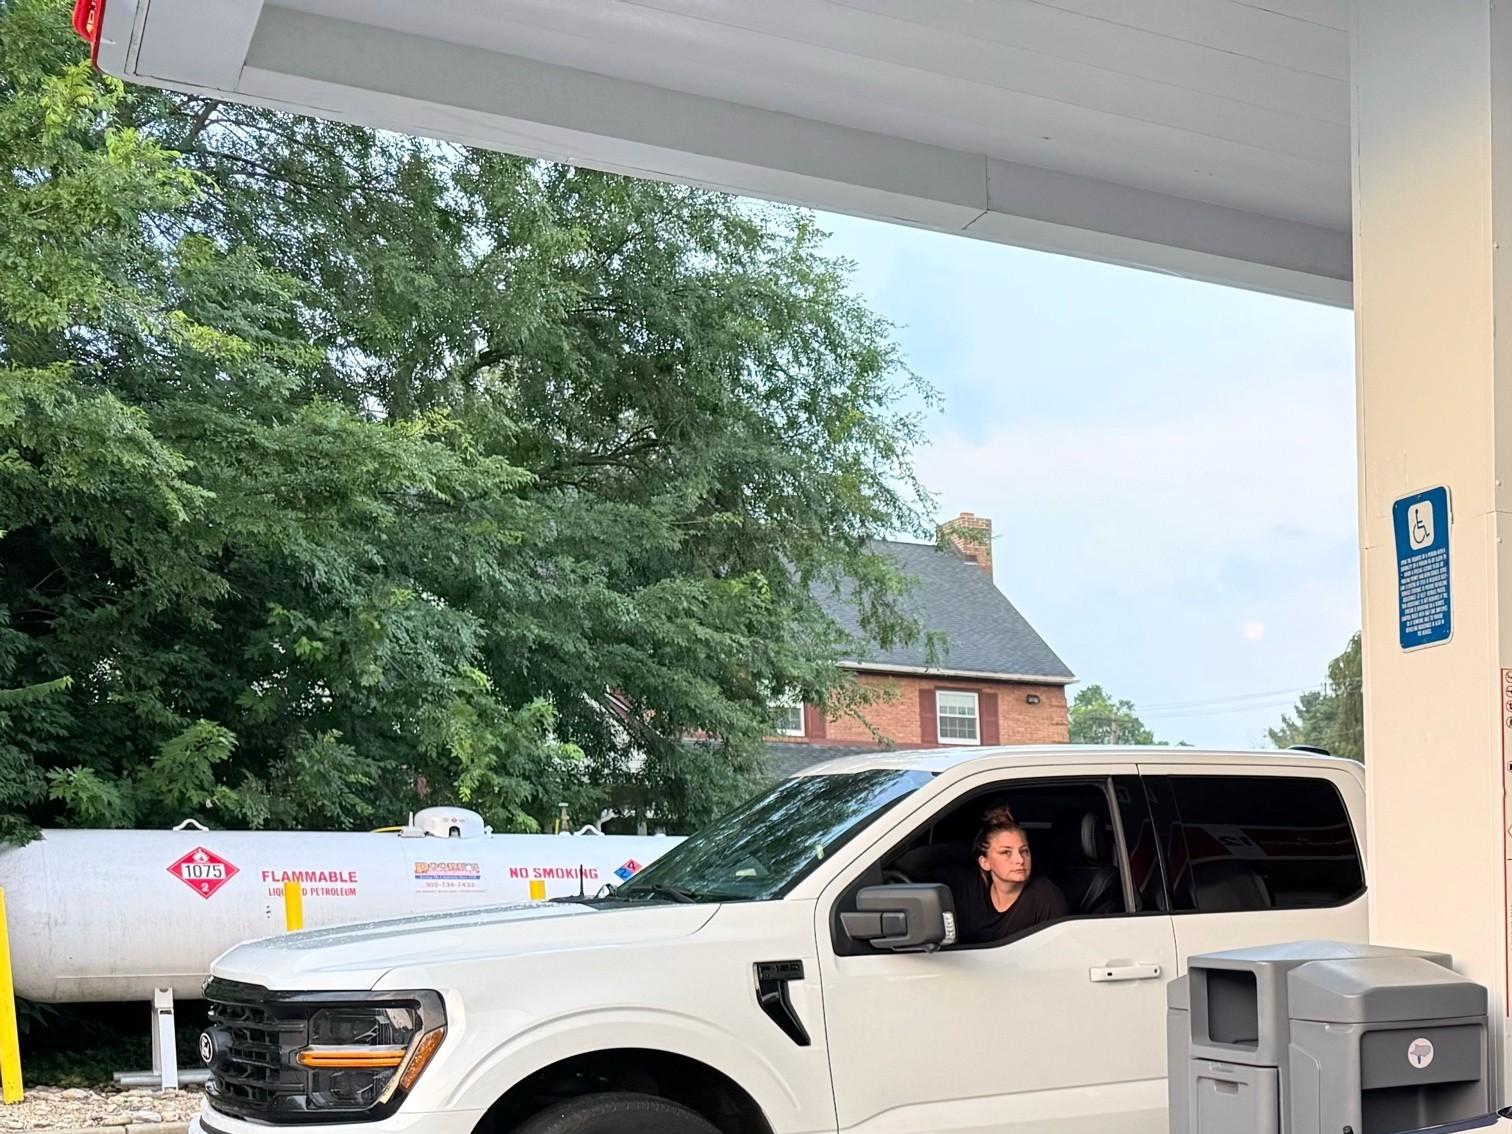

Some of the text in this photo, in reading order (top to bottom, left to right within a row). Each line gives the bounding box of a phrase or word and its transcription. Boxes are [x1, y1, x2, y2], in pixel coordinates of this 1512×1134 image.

[184, 864, 222, 878] 1075
[261, 870, 358, 883] FLAMMABLE
[509, 867, 599, 879] NO SMOKING
[202, 882, 209, 892] 2
[269, 887, 356, 896] LIQD PETROLEUM
